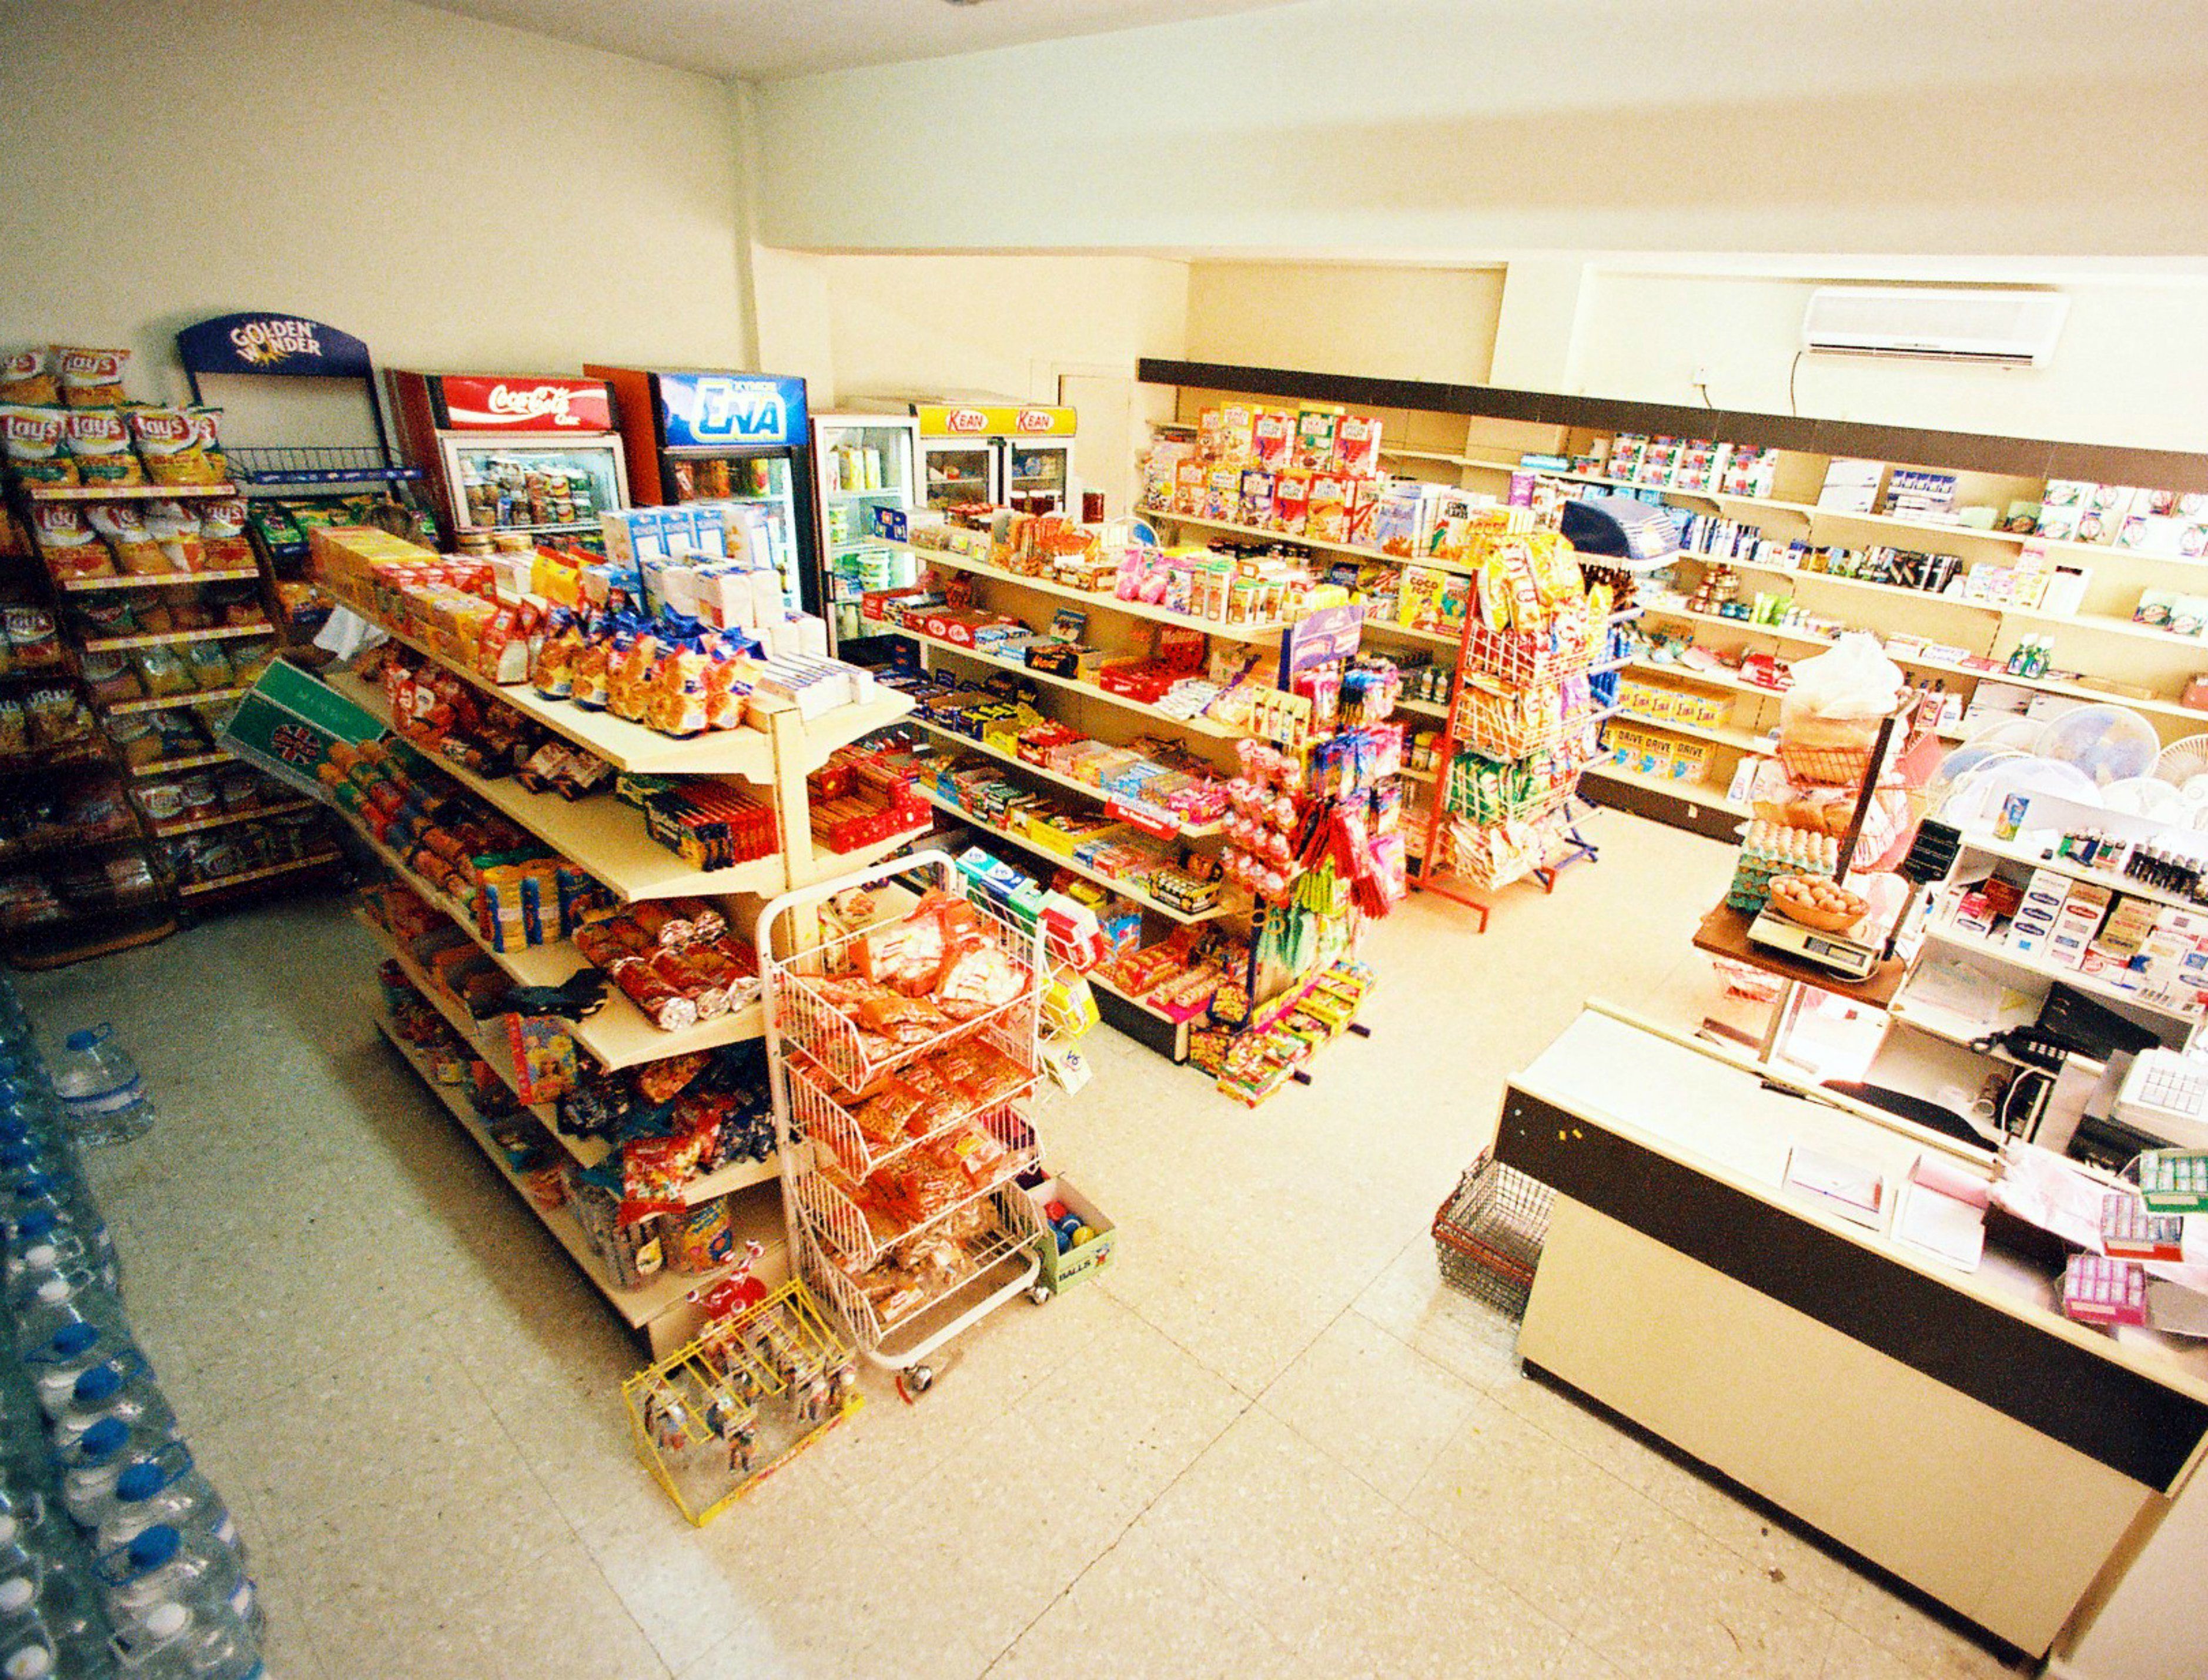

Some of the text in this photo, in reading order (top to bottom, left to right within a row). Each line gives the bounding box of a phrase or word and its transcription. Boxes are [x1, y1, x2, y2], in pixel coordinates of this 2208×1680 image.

[230, 320, 312, 347] GOLDEN
[699, 387, 779, 434] ENA
[948, 410, 983, 433] KEAN
[1017, 410, 1051, 433] KEAN
[1410, 577, 1438, 589] COCO
[1618, 731, 1642, 744] DRIVE
[1646, 738, 1670, 752] DRIVE
[1678, 743, 1703, 757] DRIVE
[1060, 1260, 1090, 1281] BALLS
